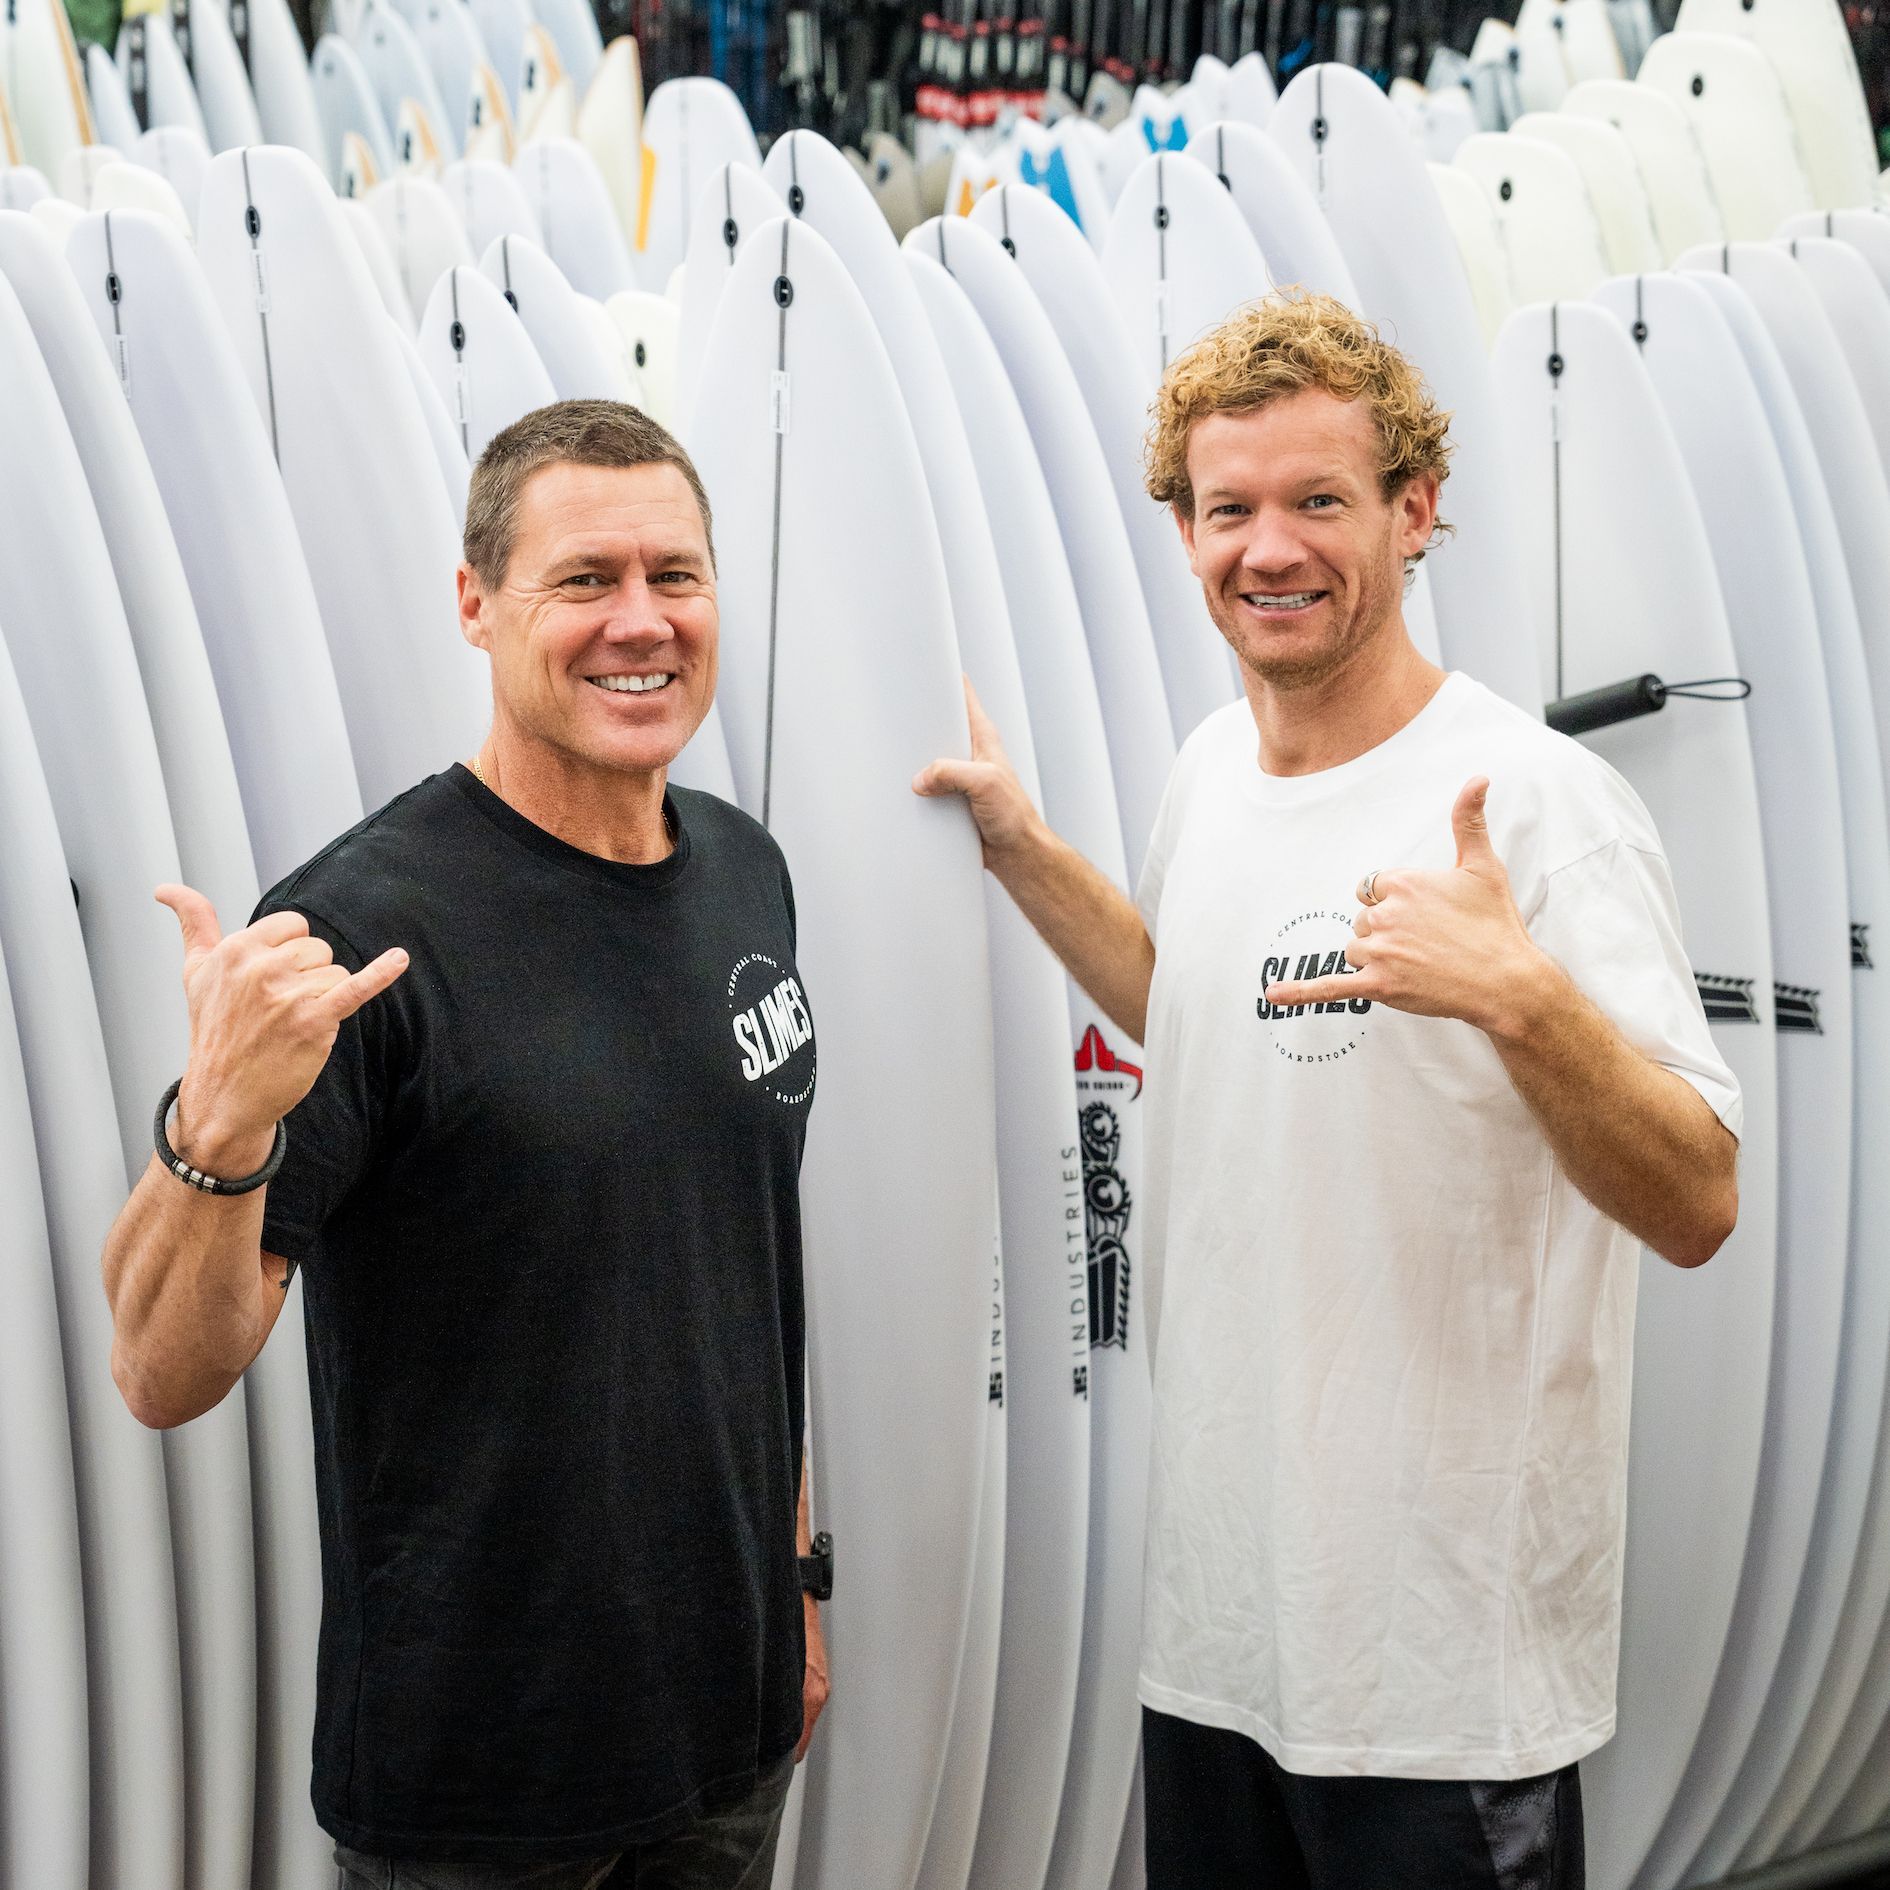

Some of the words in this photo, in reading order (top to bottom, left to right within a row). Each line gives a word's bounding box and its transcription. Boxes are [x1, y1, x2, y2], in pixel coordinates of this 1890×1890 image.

[1278, 911, 1325, 937] CENTRAL
[1332, 912, 1354, 929] COA
[728, 956, 750, 997] CENTRAL
[751, 953, 777, 968] COAST
[732, 977, 813, 1081] SLIMES
[1061, 1145, 1086, 1356] INDUSTRIES
